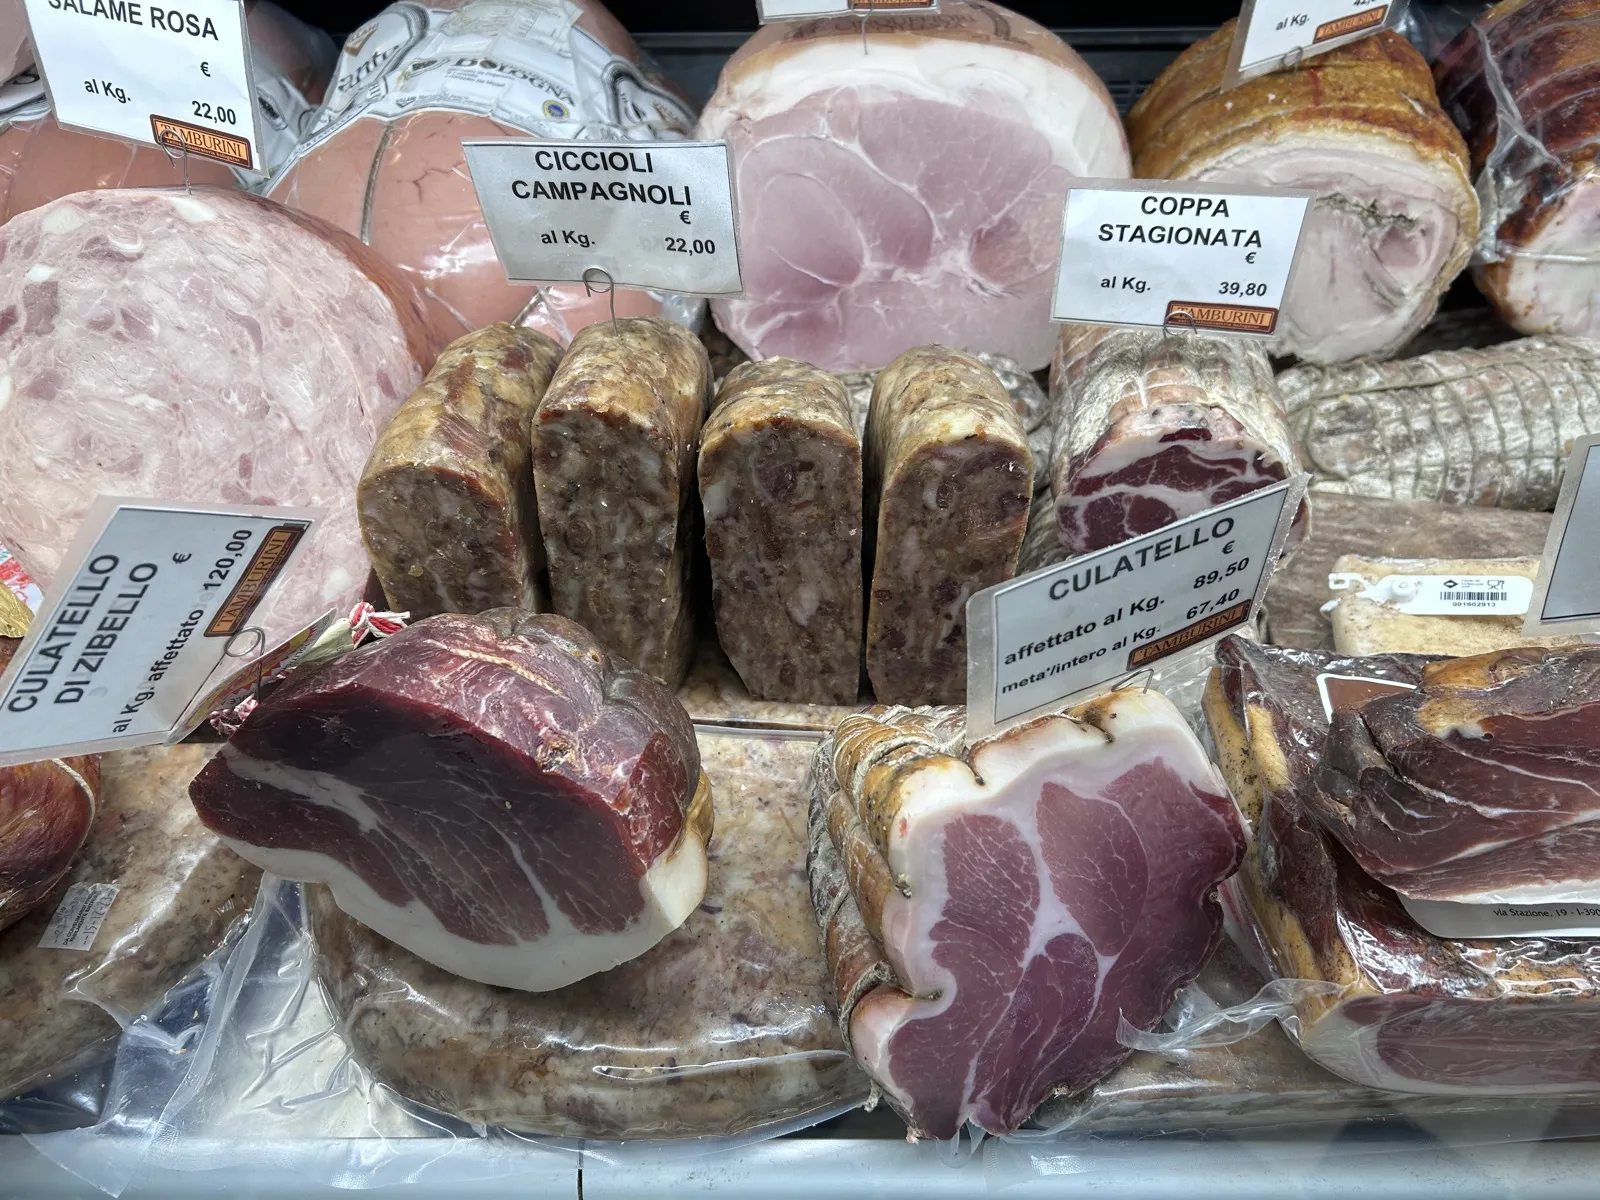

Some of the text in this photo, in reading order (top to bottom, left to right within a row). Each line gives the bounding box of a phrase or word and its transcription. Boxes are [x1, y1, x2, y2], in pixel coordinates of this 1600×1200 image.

[150, 6, 219, 41] ROSA
[1276, 13, 1311, 31] al Kg.
[199, 61, 211, 77] €
[84, 78, 99, 94] al
[102, 80, 132, 104] Kg.
[191, 100, 236, 125] 22,00
[161, 124, 242, 157] TAMBURINI
[535, 150, 654, 174] CICCIOLI
[511, 180, 692, 206] CAMPAGNOLI
[679, 210, 691, 225] €
[1141, 195, 1230, 218] COPPA
[541, 230, 716, 256] al Kg. 22,00
[1098, 223, 1262, 249] STAGIONATA
[1245, 251, 1257, 265] €
[1100, 276, 1267, 297] al Kg. 39,80
[1177, 307, 1265, 325] TAMBURINI
[172, 552, 192, 565] €
[1049, 517, 1235, 601] CULATELLO
[1222, 540, 1235, 555] €
[216, 539, 285, 627] TAMBURINI
[1193, 557, 1250, 590] 89,50
[8, 554, 120, 712] CULATELLO
[53, 562, 158, 704] DI ZIBELLO
[113, 529, 252, 733] al Kg. affettato 120,00
[1001, 587, 1240, 694] meta'/intero al Kg. 67,40
[1003, 595, 1165, 665] affettato al Kg.
[1140, 610, 1237, 658] TAMBURINI
[1509, 908, 1553, 918] Stazione,
[1556, 909, 1568, 917] 19
